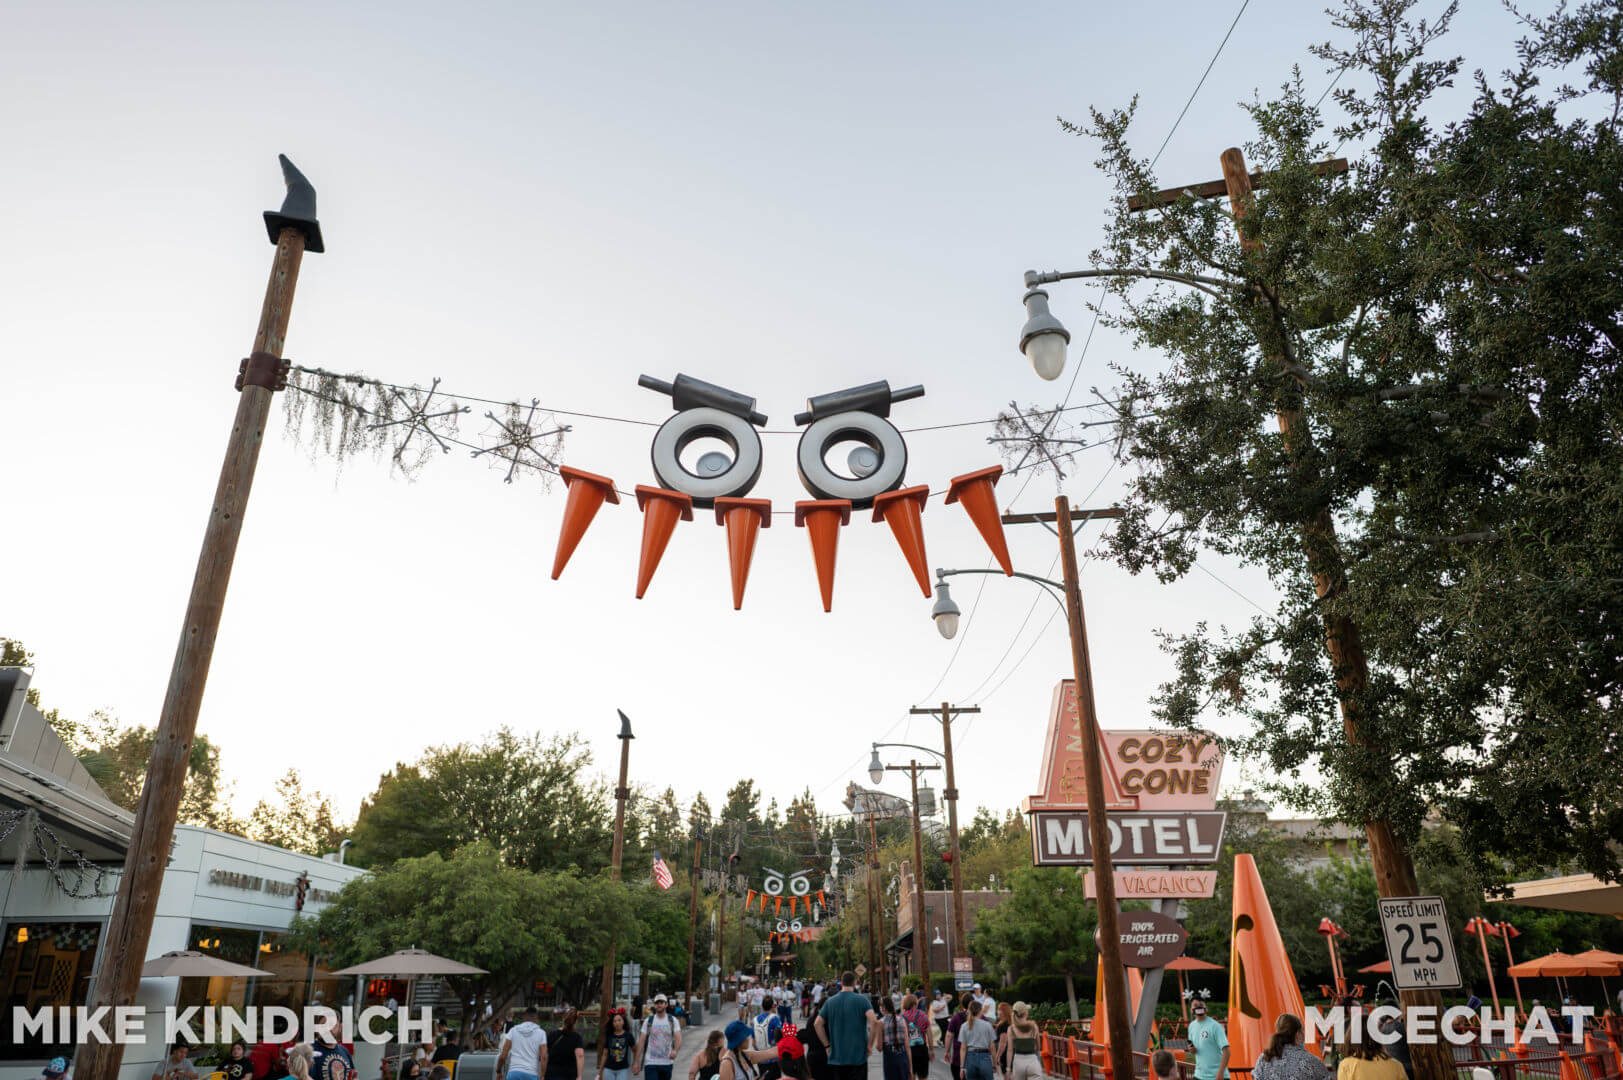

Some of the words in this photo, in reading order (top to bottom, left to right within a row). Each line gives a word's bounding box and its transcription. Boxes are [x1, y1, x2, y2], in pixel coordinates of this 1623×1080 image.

[1118, 737, 1206, 763] COZY
[1121, 768, 1210, 794] CONE
[1122, 875, 1208, 894] VACANCY
[1384, 905, 1413, 918] SPEED
[1416, 904, 1440, 917] LIMIT
[1131, 922, 1155, 932] 100%
[1137, 945, 1154, 956] AIR
[1394, 923, 1444, 964] 25
[1414, 968, 1437, 981] MPH
